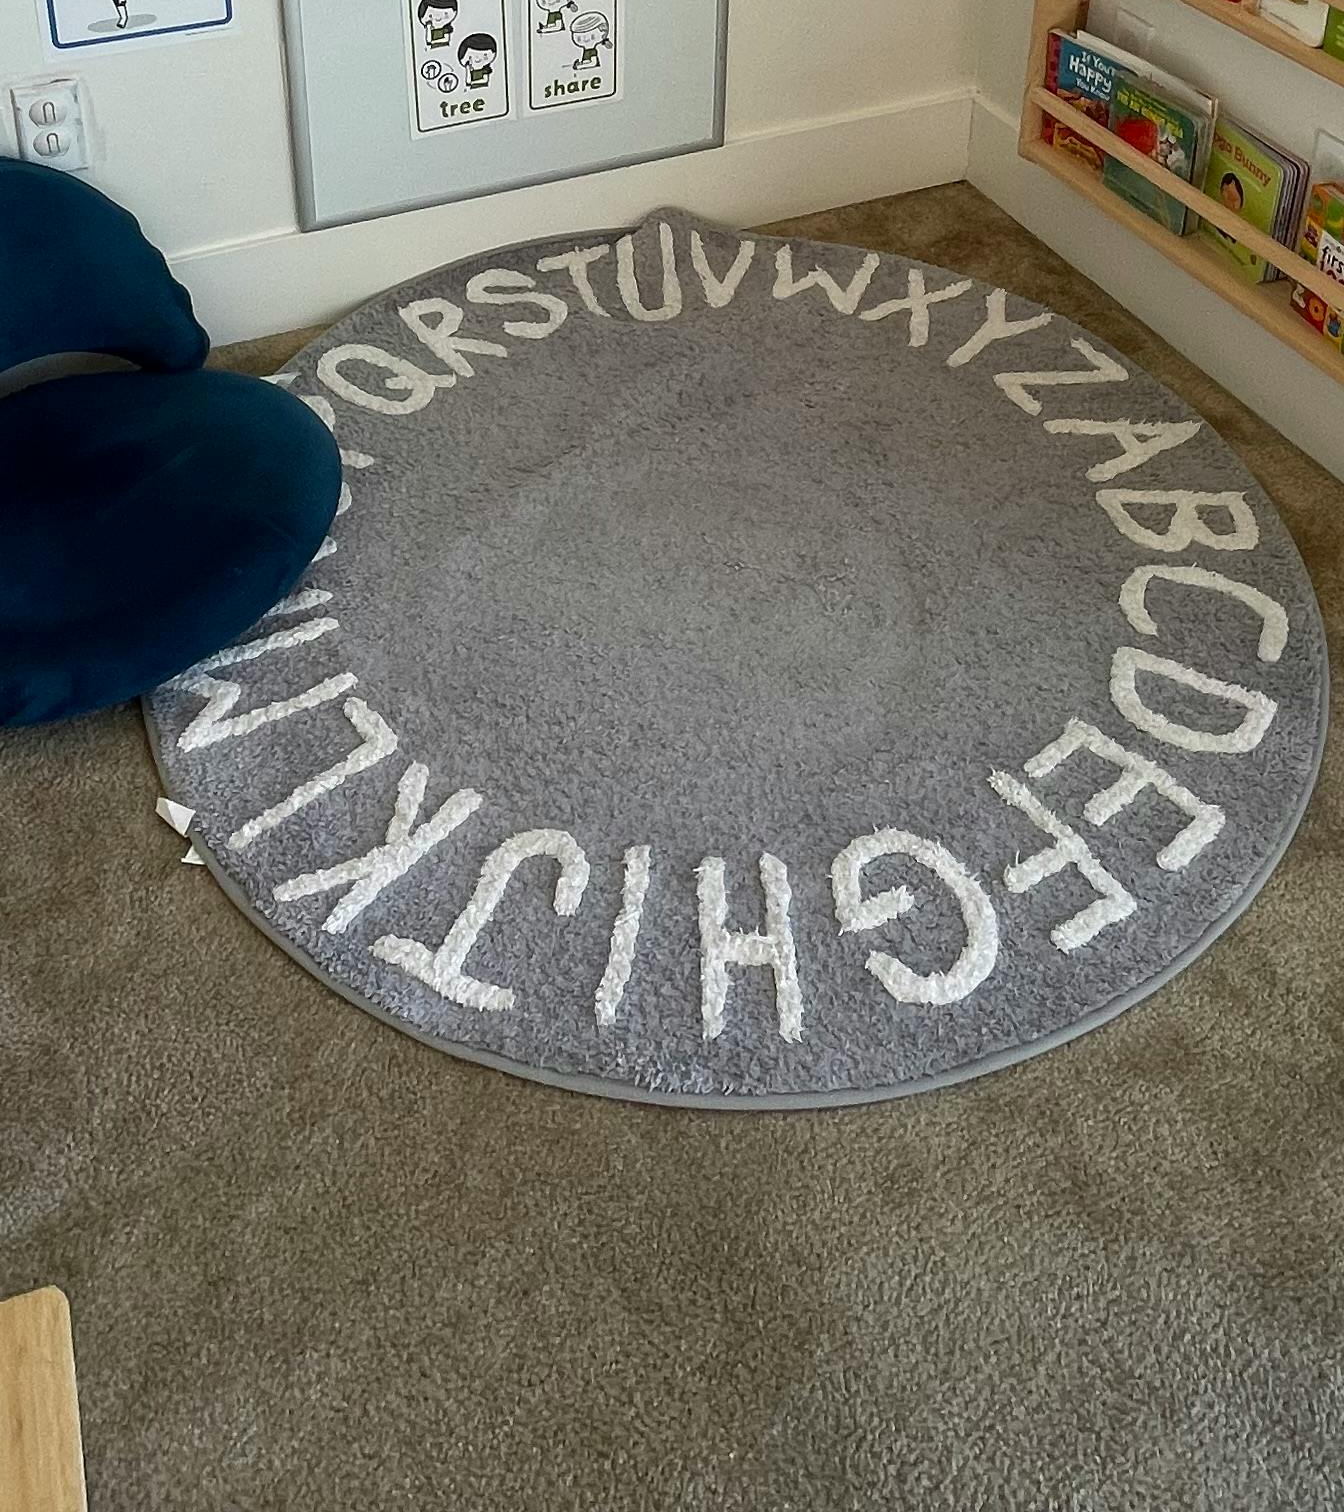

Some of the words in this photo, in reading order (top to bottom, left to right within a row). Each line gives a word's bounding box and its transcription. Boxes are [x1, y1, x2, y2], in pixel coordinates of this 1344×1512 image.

[544, 74, 601, 97] share
[1069, 56, 1112, 92] Happy
[440, 96, 485, 118] tree
[1235, 143, 1271, 186] Bunny
